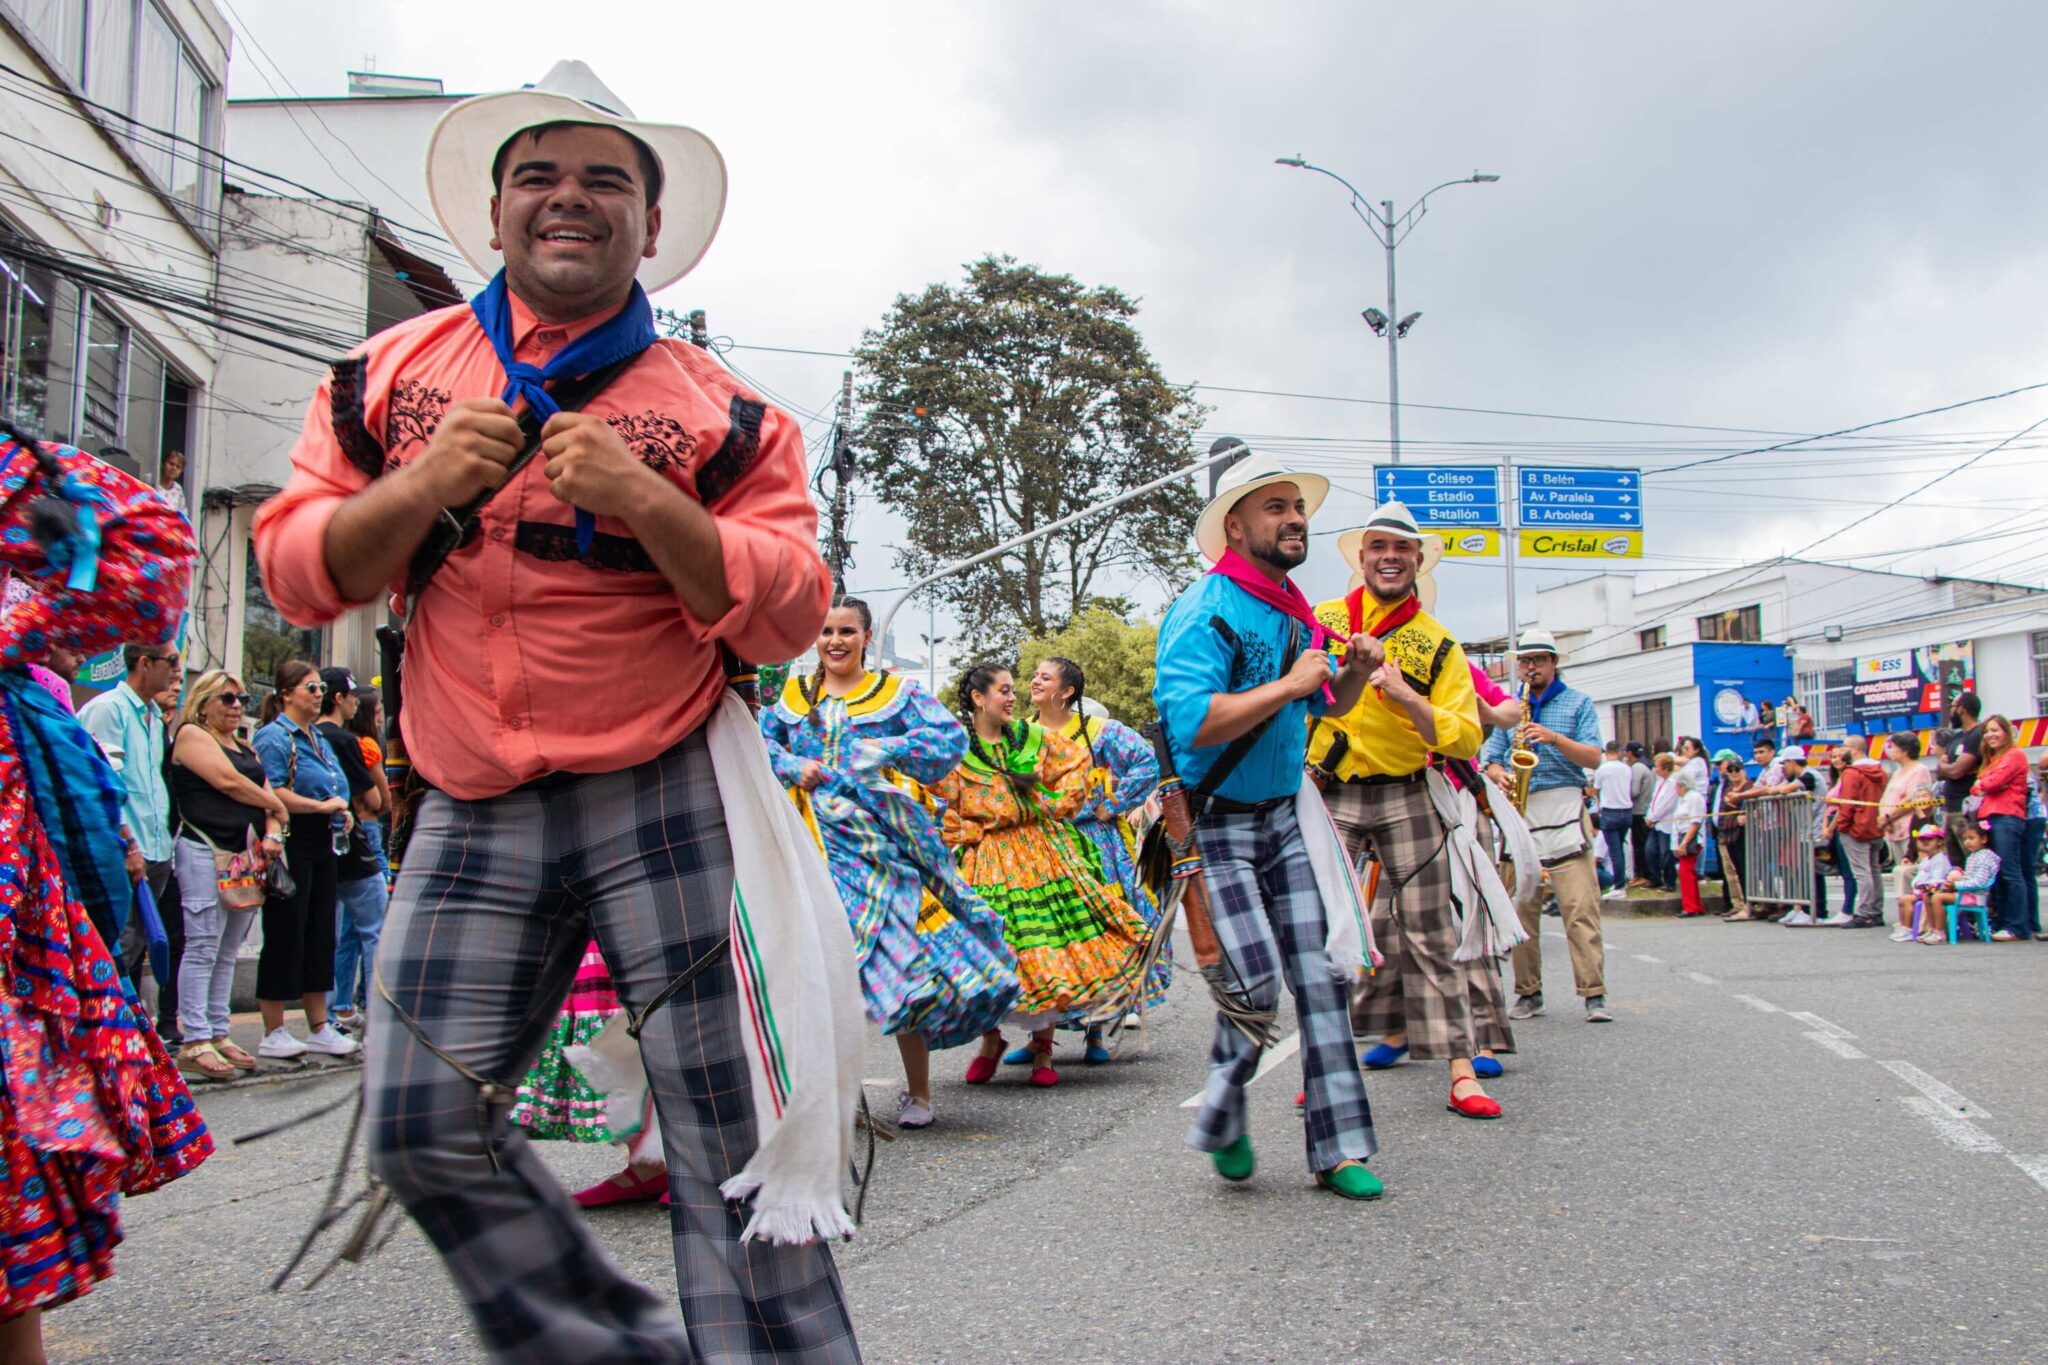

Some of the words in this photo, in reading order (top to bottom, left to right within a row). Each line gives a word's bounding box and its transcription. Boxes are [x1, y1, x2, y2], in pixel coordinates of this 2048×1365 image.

[1428, 472, 1474, 484] Coliseo
[1528, 473, 1540, 484] B.
[1543, 473, 1575, 485] Belén
[1428, 490, 1474, 502] Estadio
[1529, 491, 1547, 502] Av.
[1549, 492, 1595, 503] Paralela
[1430, 508, 1480, 520] Batallón
[1529, 509, 1541, 520] B.
[1543, 509, 1595, 521] Arboleda
[1533, 535, 1598, 553] Cristal
